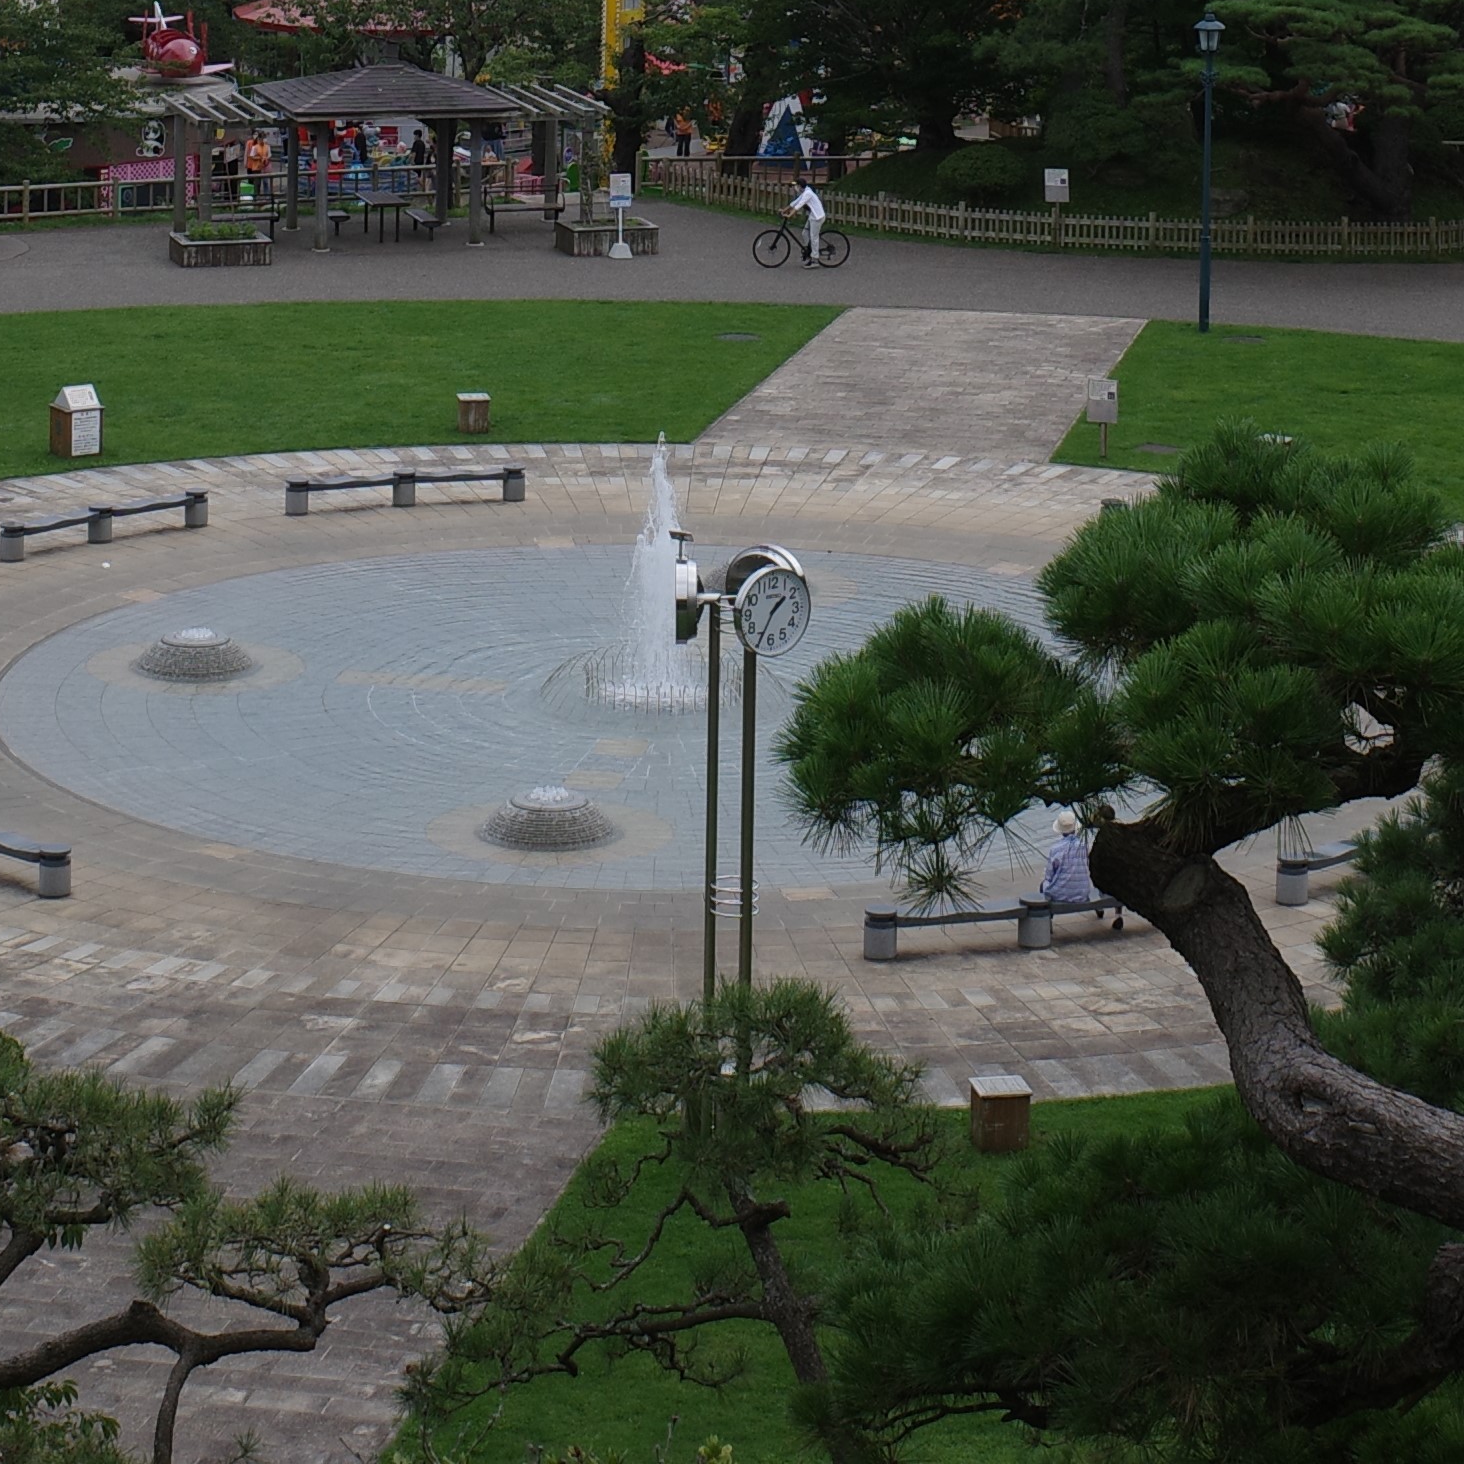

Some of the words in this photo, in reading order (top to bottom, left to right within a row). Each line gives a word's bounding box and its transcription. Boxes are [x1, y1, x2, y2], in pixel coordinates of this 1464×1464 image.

[757, 581, 766, 594] 11
[768, 577, 778, 589] 12
[789, 587, 796, 599] 2
[747, 594, 758, 606] 10
[792, 602, 799, 614] 3
[744, 609, 752, 621] 9
[788, 616, 795, 627] 4
[748, 622, 755, 634] 8
[779, 628, 786, 640] 5
[767, 634, 774, 645] 6
